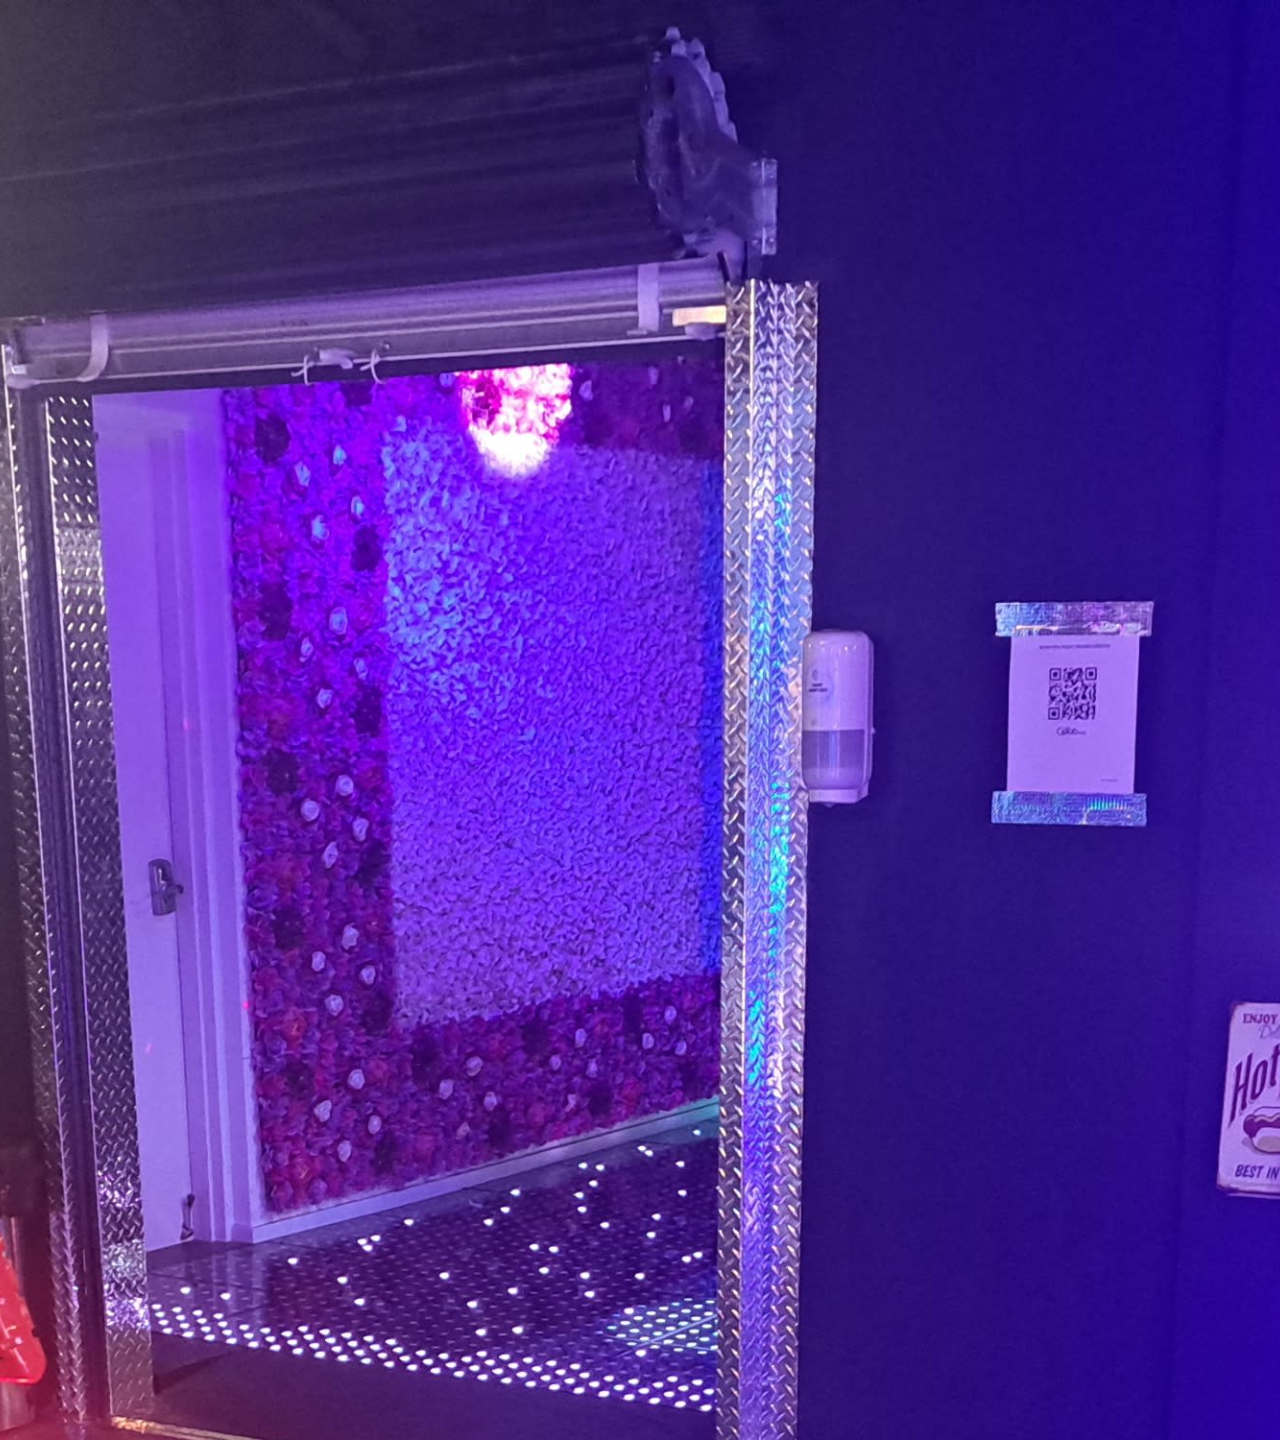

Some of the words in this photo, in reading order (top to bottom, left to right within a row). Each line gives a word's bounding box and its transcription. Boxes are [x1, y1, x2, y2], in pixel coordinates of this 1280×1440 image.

[1242, 1013, 1277, 1026] ENJOY
[1234, 1163, 1265, 1179] BEST
[1266, 1165, 1280, 1180] IN
